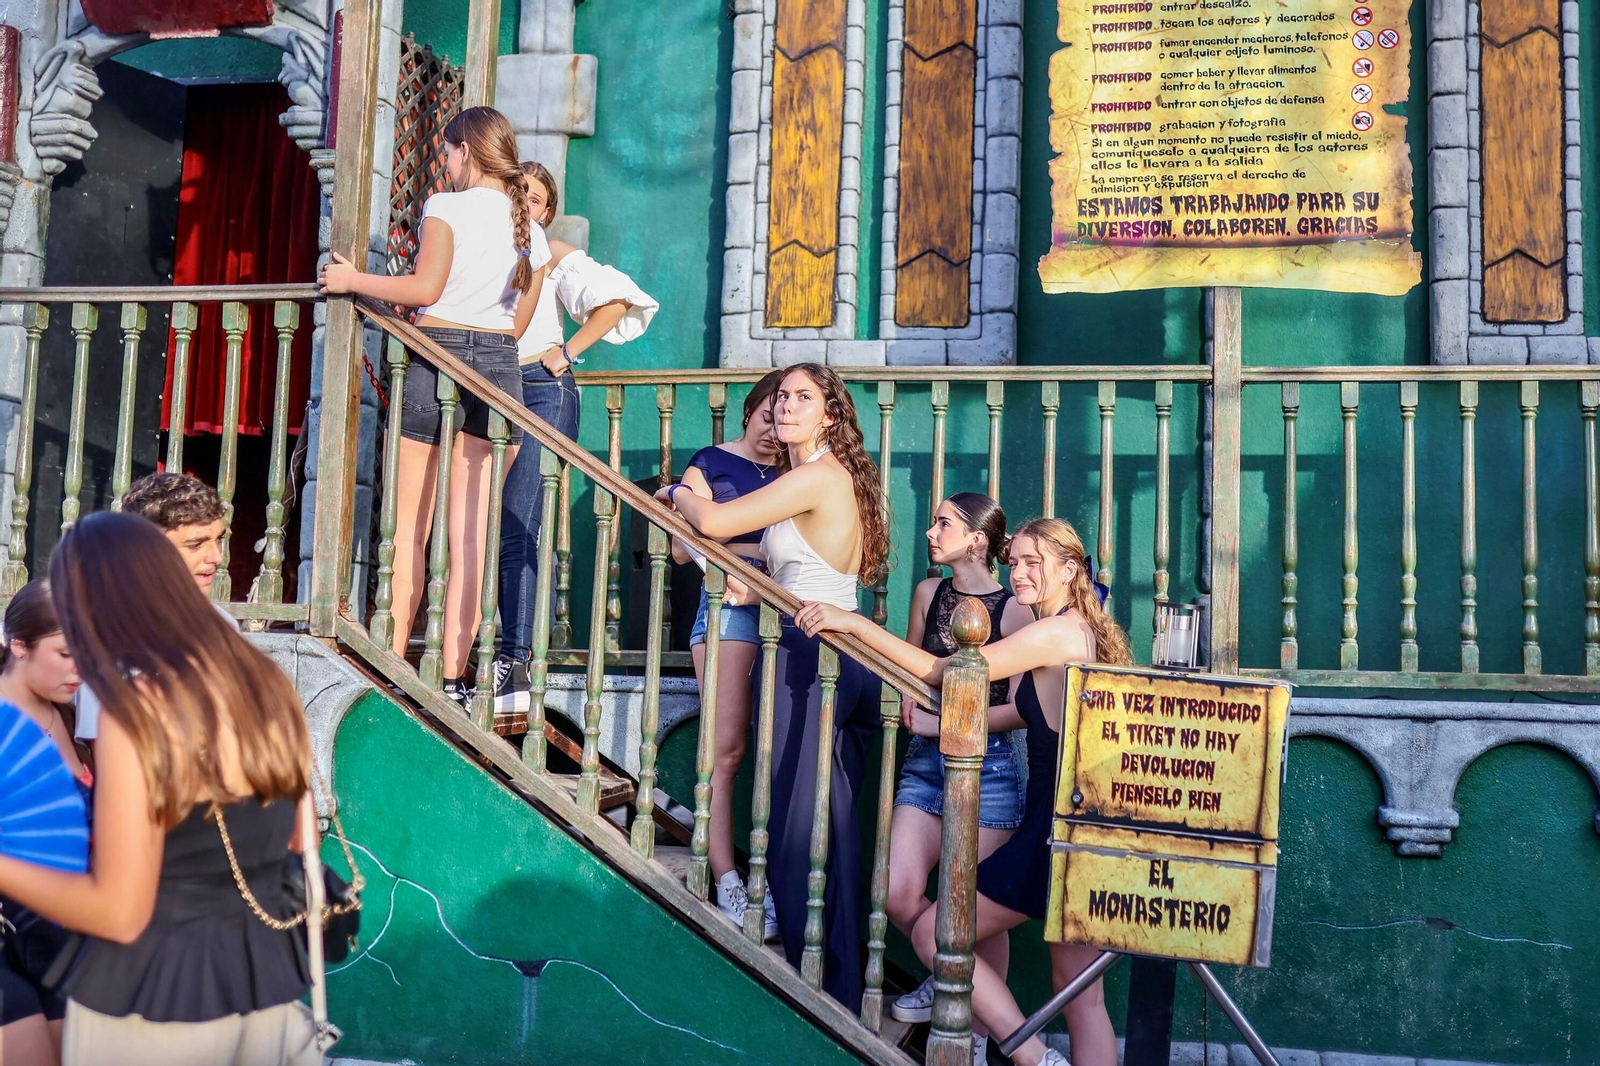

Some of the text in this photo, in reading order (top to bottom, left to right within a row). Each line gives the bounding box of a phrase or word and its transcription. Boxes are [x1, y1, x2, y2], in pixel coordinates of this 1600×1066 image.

[1092, 0, 1252, 15] PROHIBIDO entrar descalzo.
[1092, 21, 1153, 34] PROHIBIDO
[1198, 17, 1214, 27] los
[1217, 15, 1260, 26] actores
[1265, 16, 1271, 26] y
[1277, 12, 1335, 23] decorados
[1092, 41, 1153, 53] PROHIBIDO
[1160, 39, 1190, 48] fumar
[1193, 36, 1239, 46] encender
[1296, 32, 1348, 41] telefonos
[1169, 49, 1221, 59] cualquier
[1264, 45, 1316, 54] luminoso.
[1092, 64, 1316, 85] PROHIBIDO comer beber y llevar alimentos
[1161, 80, 1285, 91] dentro de la atraccion.
[1091, 95, 1324, 113] PROHIBIDO entrar con objetos de defensa
[1091, 117, 1286, 135] PROHIBIDO grabacion y fotografia
[1092, 138, 1102, 147] Si
[1106, 139, 1119, 147] en
[1124, 137, 1154, 149] algun
[1158, 135, 1207, 145] momento
[1211, 136, 1224, 144] no
[1229, 133, 1261, 144] puede
[1266, 131, 1307, 141] resistir
[1312, 131, 1322, 140] el
[1092, 147, 1184, 159] comuniqueselo
[1203, 145, 1270, 156] cualquiera
[1275, 144, 1289, 152] de
[1295, 143, 1313, 152] los
[1318, 142, 1368, 152] actores
[1091, 160, 1121, 170] ellos
[1127, 160, 1138, 169] le
[1143, 159, 1189, 168] llevara
[1207, 157, 1219, 166] la
[1225, 156, 1263, 166] salida
[1091, 183, 1139, 194] admision
[1155, 180, 1209, 190] expulsion
[1092, 175, 1104, 184] La
[1109, 175, 1156, 184] empresa
[1179, 173, 1223, 183] reserva
[1227, 170, 1237, 180] el
[1242, 170, 1288, 179] derecho
[1293, 170, 1306, 178] de
[1077, 192, 1379, 218] ESTAMOS TRABAJANDO PARA SU
[1077, 216, 1378, 240] DIVERSION, COLABOREN. GRACIAS
[1122, 693, 1154, 715] VEZ
[1160, 696, 1262, 724] INTRODUCIDO
[1101, 721, 1241, 754] EL TIKET NO HAY
[1120, 752, 1216, 782] DEVOLUCION
[1111, 781, 1222, 813] PIENSELO BIEN
[1148, 859, 1175, 892] EL
[1088, 889, 1231, 935] MONASTERIO
